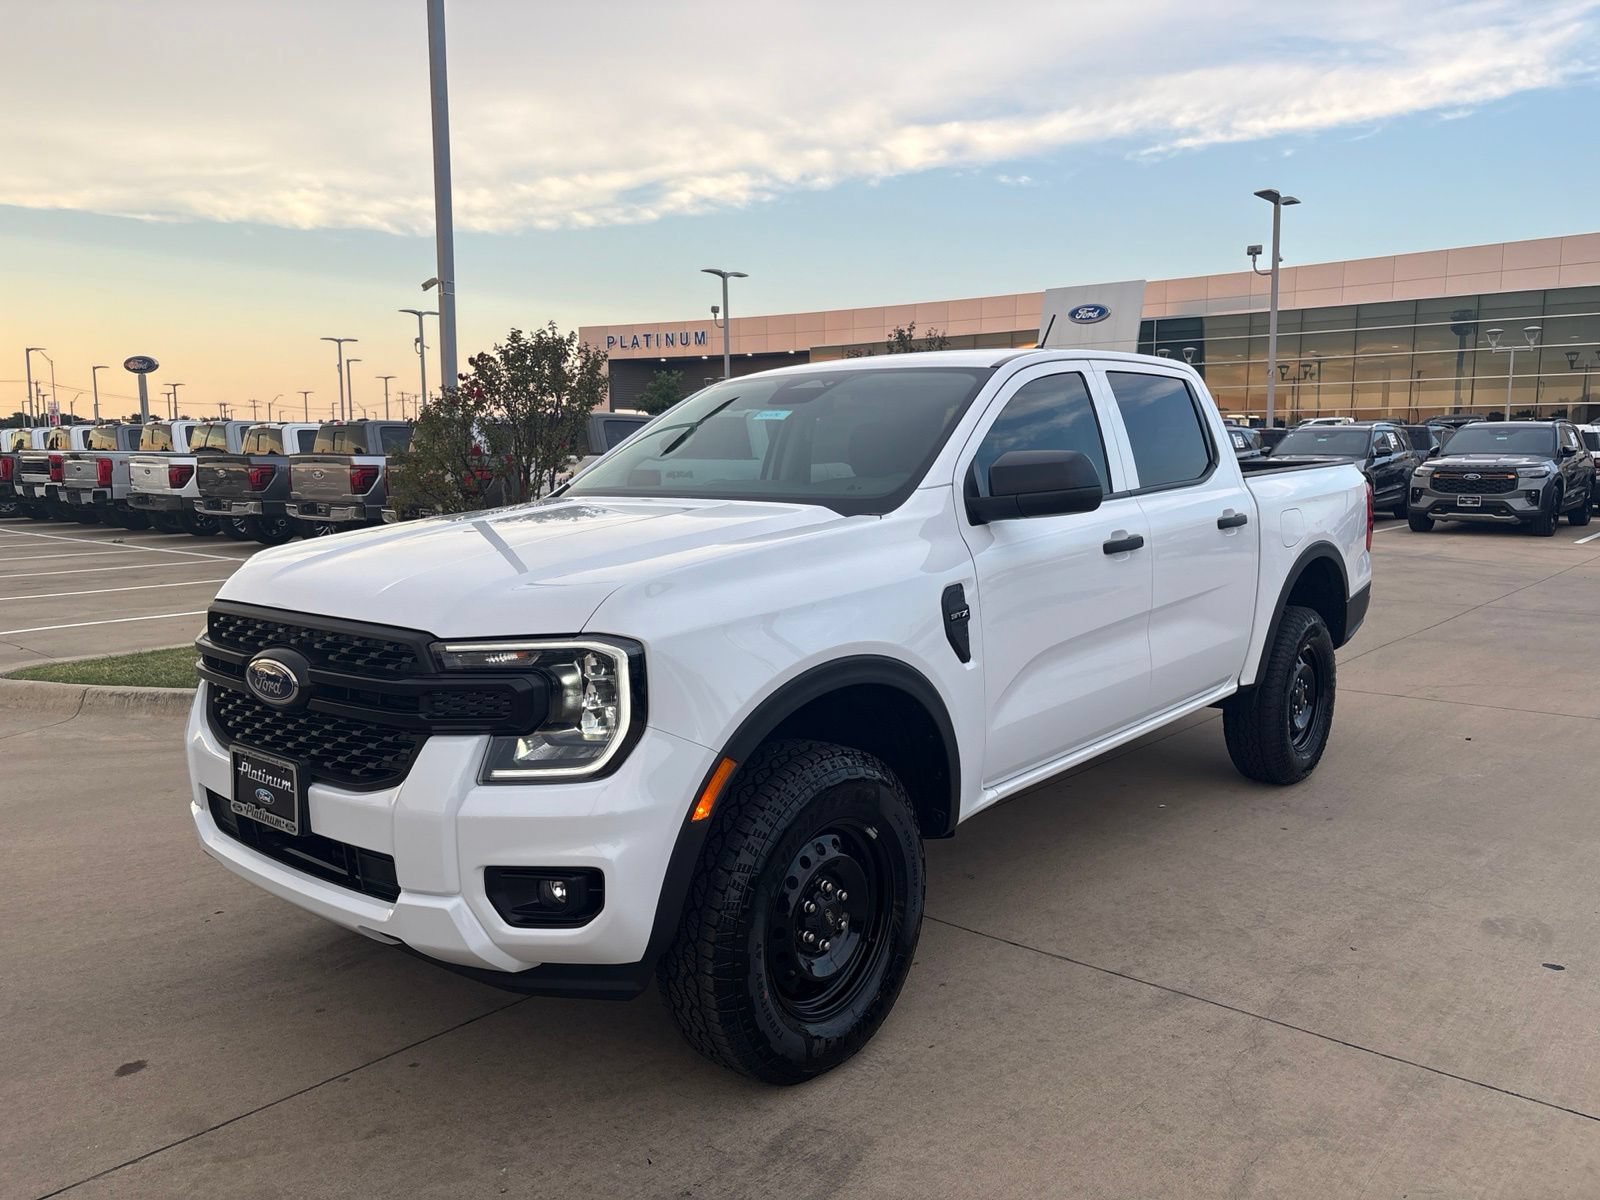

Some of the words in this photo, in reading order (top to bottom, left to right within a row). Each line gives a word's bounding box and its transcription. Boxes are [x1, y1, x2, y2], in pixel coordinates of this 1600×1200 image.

[607, 331, 706, 349] PLATINUM
[254, 668, 284, 695] Ford
[237, 761, 295, 793] Platinum
[246, 802, 283, 828] Platinum
